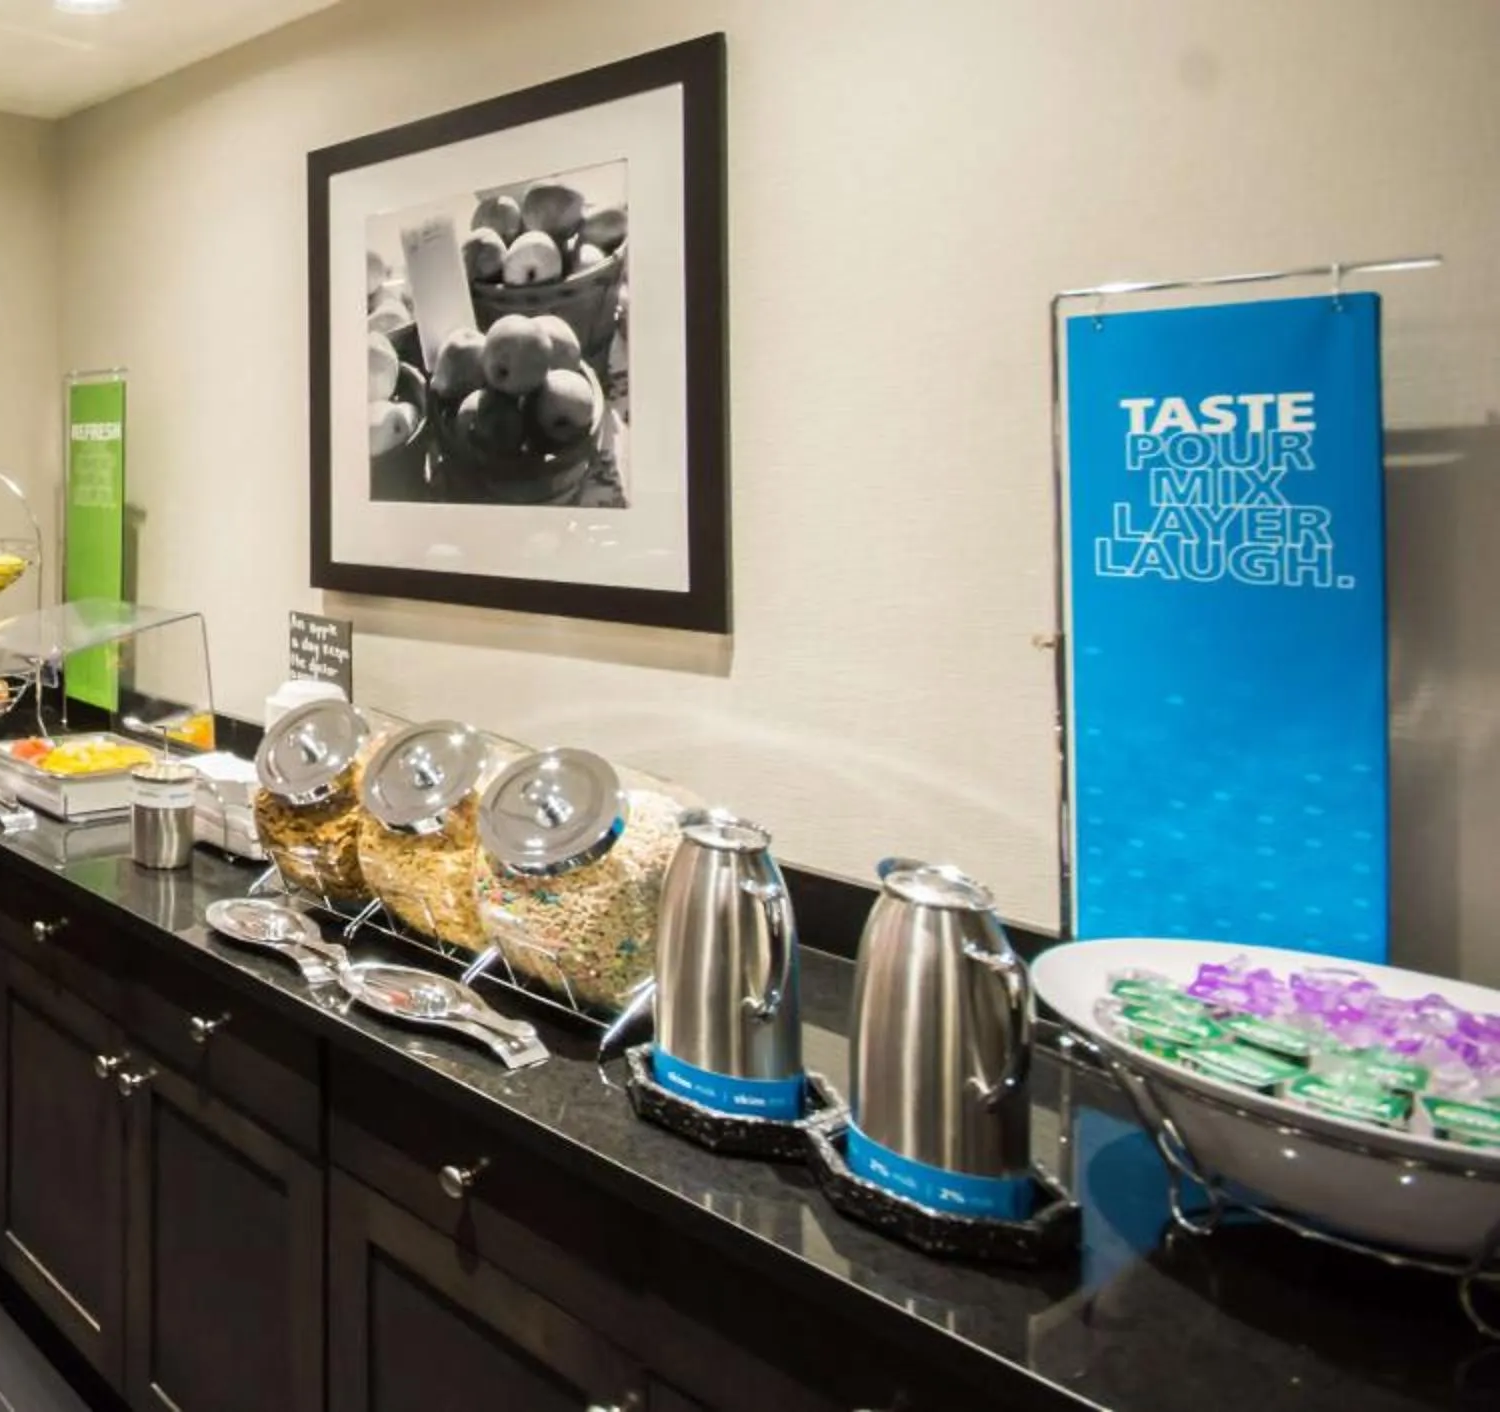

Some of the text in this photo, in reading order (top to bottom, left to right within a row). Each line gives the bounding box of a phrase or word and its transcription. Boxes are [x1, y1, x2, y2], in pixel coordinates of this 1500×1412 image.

[1119, 392, 1316, 434] TASTE
[1126, 429, 1315, 471] POUR
[1149, 466, 1290, 508] MIX
[1113, 502, 1333, 549] LAYER
[1095, 537, 1356, 589] LAUGH.
